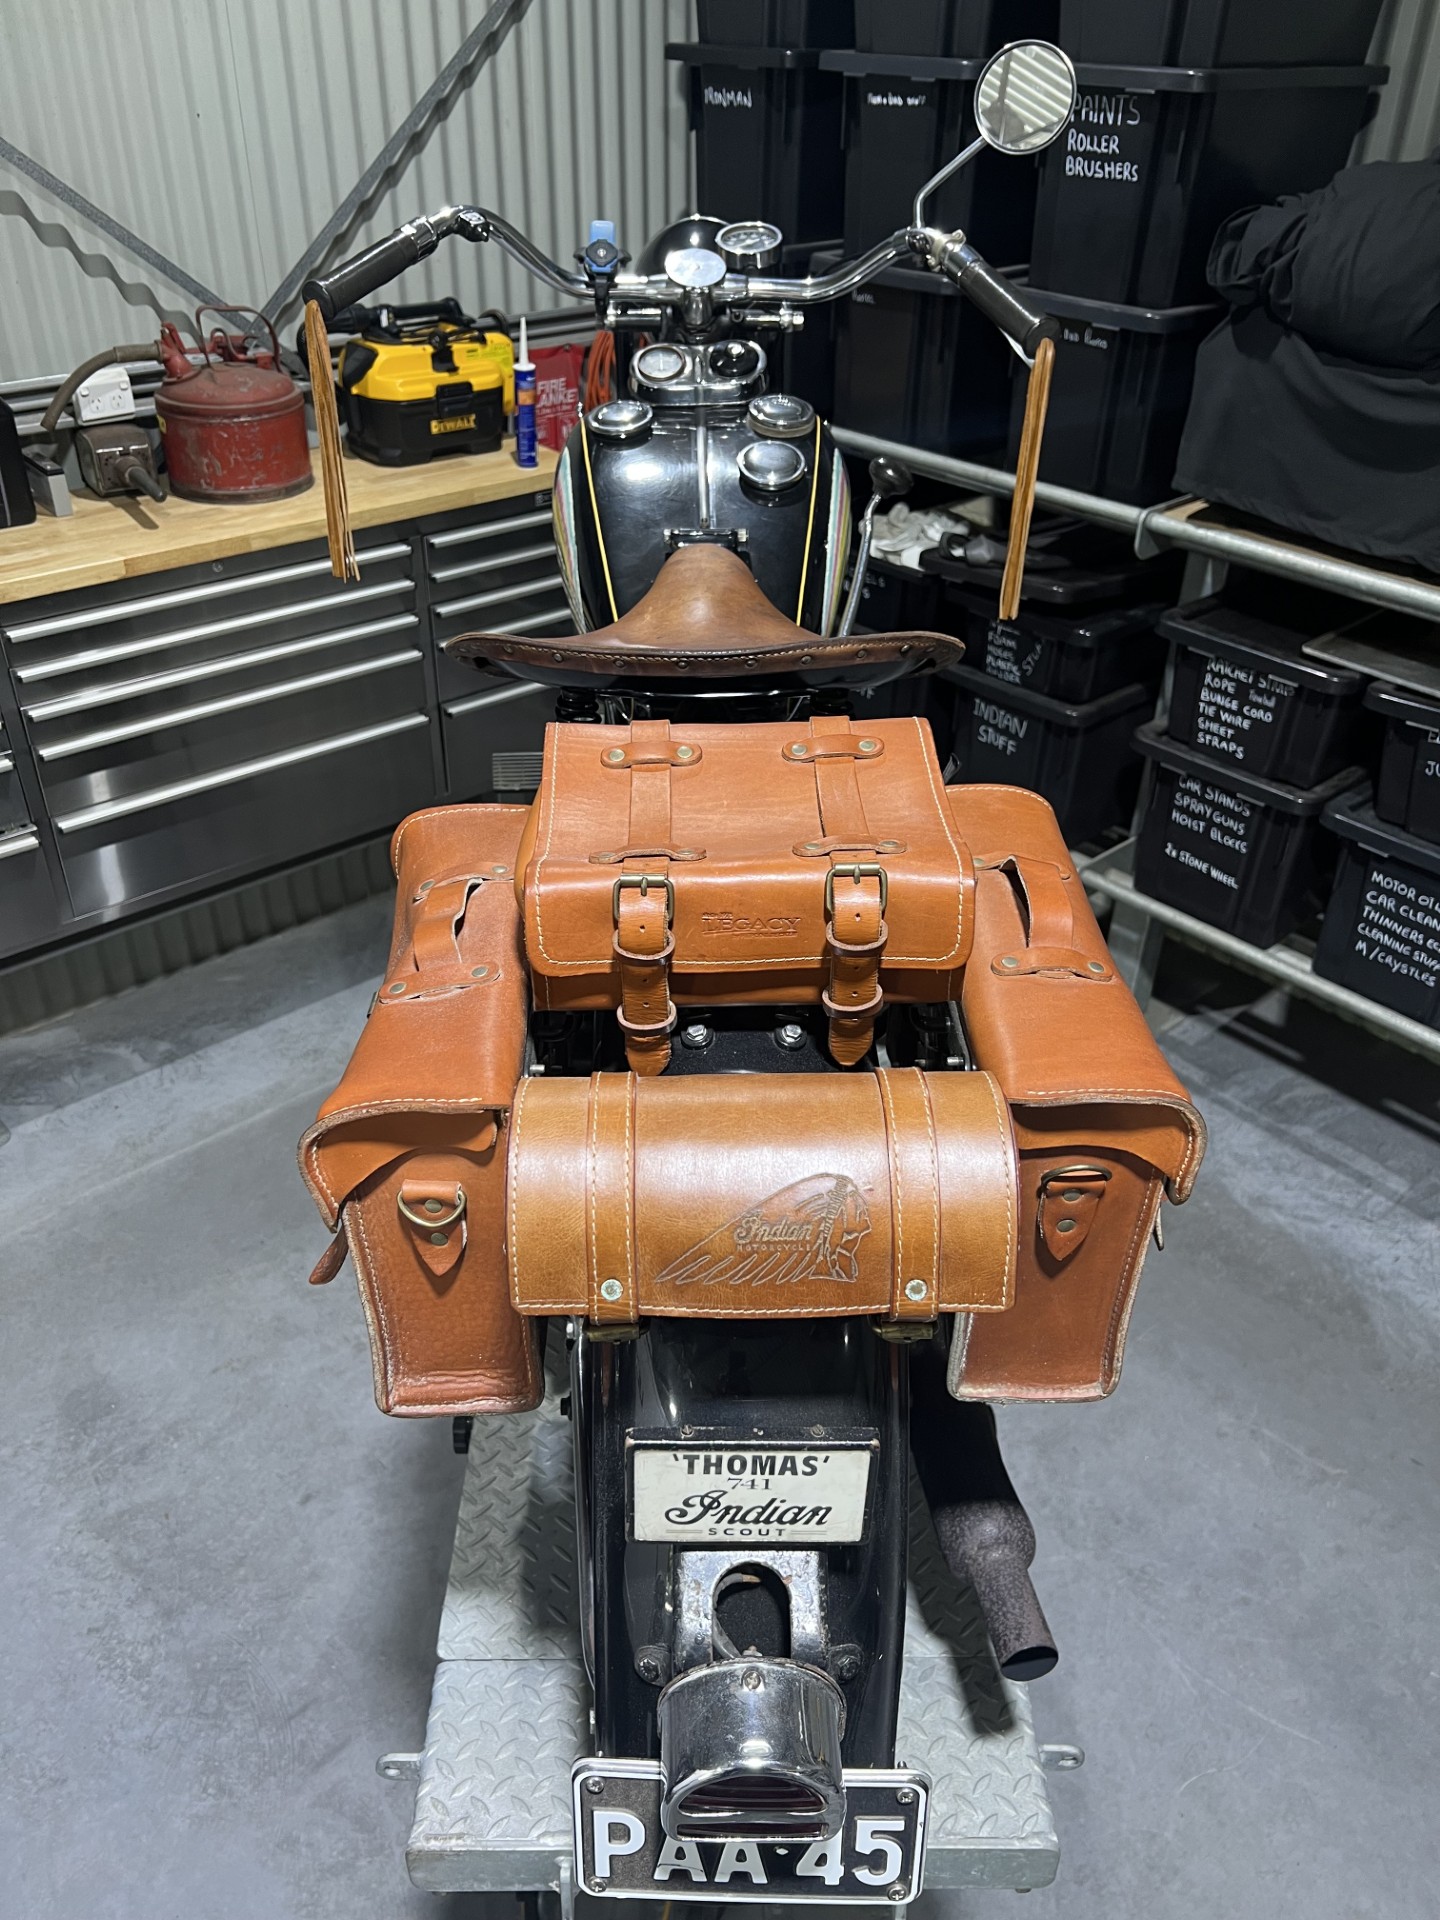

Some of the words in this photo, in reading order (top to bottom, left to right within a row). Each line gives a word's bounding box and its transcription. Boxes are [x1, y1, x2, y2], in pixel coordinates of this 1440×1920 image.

[1070, 92, 1140, 126] PAINTS
[1067, 128, 1119, 155] ROLLER
[1065, 155, 1138, 182] BRUSHERS
[536, 377, 566, 395] FIRE
[430, 413, 476, 435] DEWALT
[1204, 672, 1237, 695] ROPE
[973, 697, 1028, 739] INDIAN
[1219, 709, 1252, 731] WIRE
[977, 724, 1017, 756] STUFF
[1197, 731, 1245, 760] STRAPS
[1178, 774, 1202, 797] CAR
[1204, 785, 1250, 818] STANDS
[1171, 808, 1205, 834] HOIST
[1178, 850, 1209, 874] STONE
[1371, 870, 1416, 902] MOTOR
[1366, 890, 1396, 914] CAR
[702, 917, 800, 933] LEGACY
[1363, 905, 1424, 946] THINNERS
[1357, 922, 1412, 956] CLEANING
[734, 1209, 813, 1244] Indian
[726, 1477, 773, 1491] 741
[664, 1489, 832, 1526] Indian
[708, 1527, 787, 1538] SCOUT
